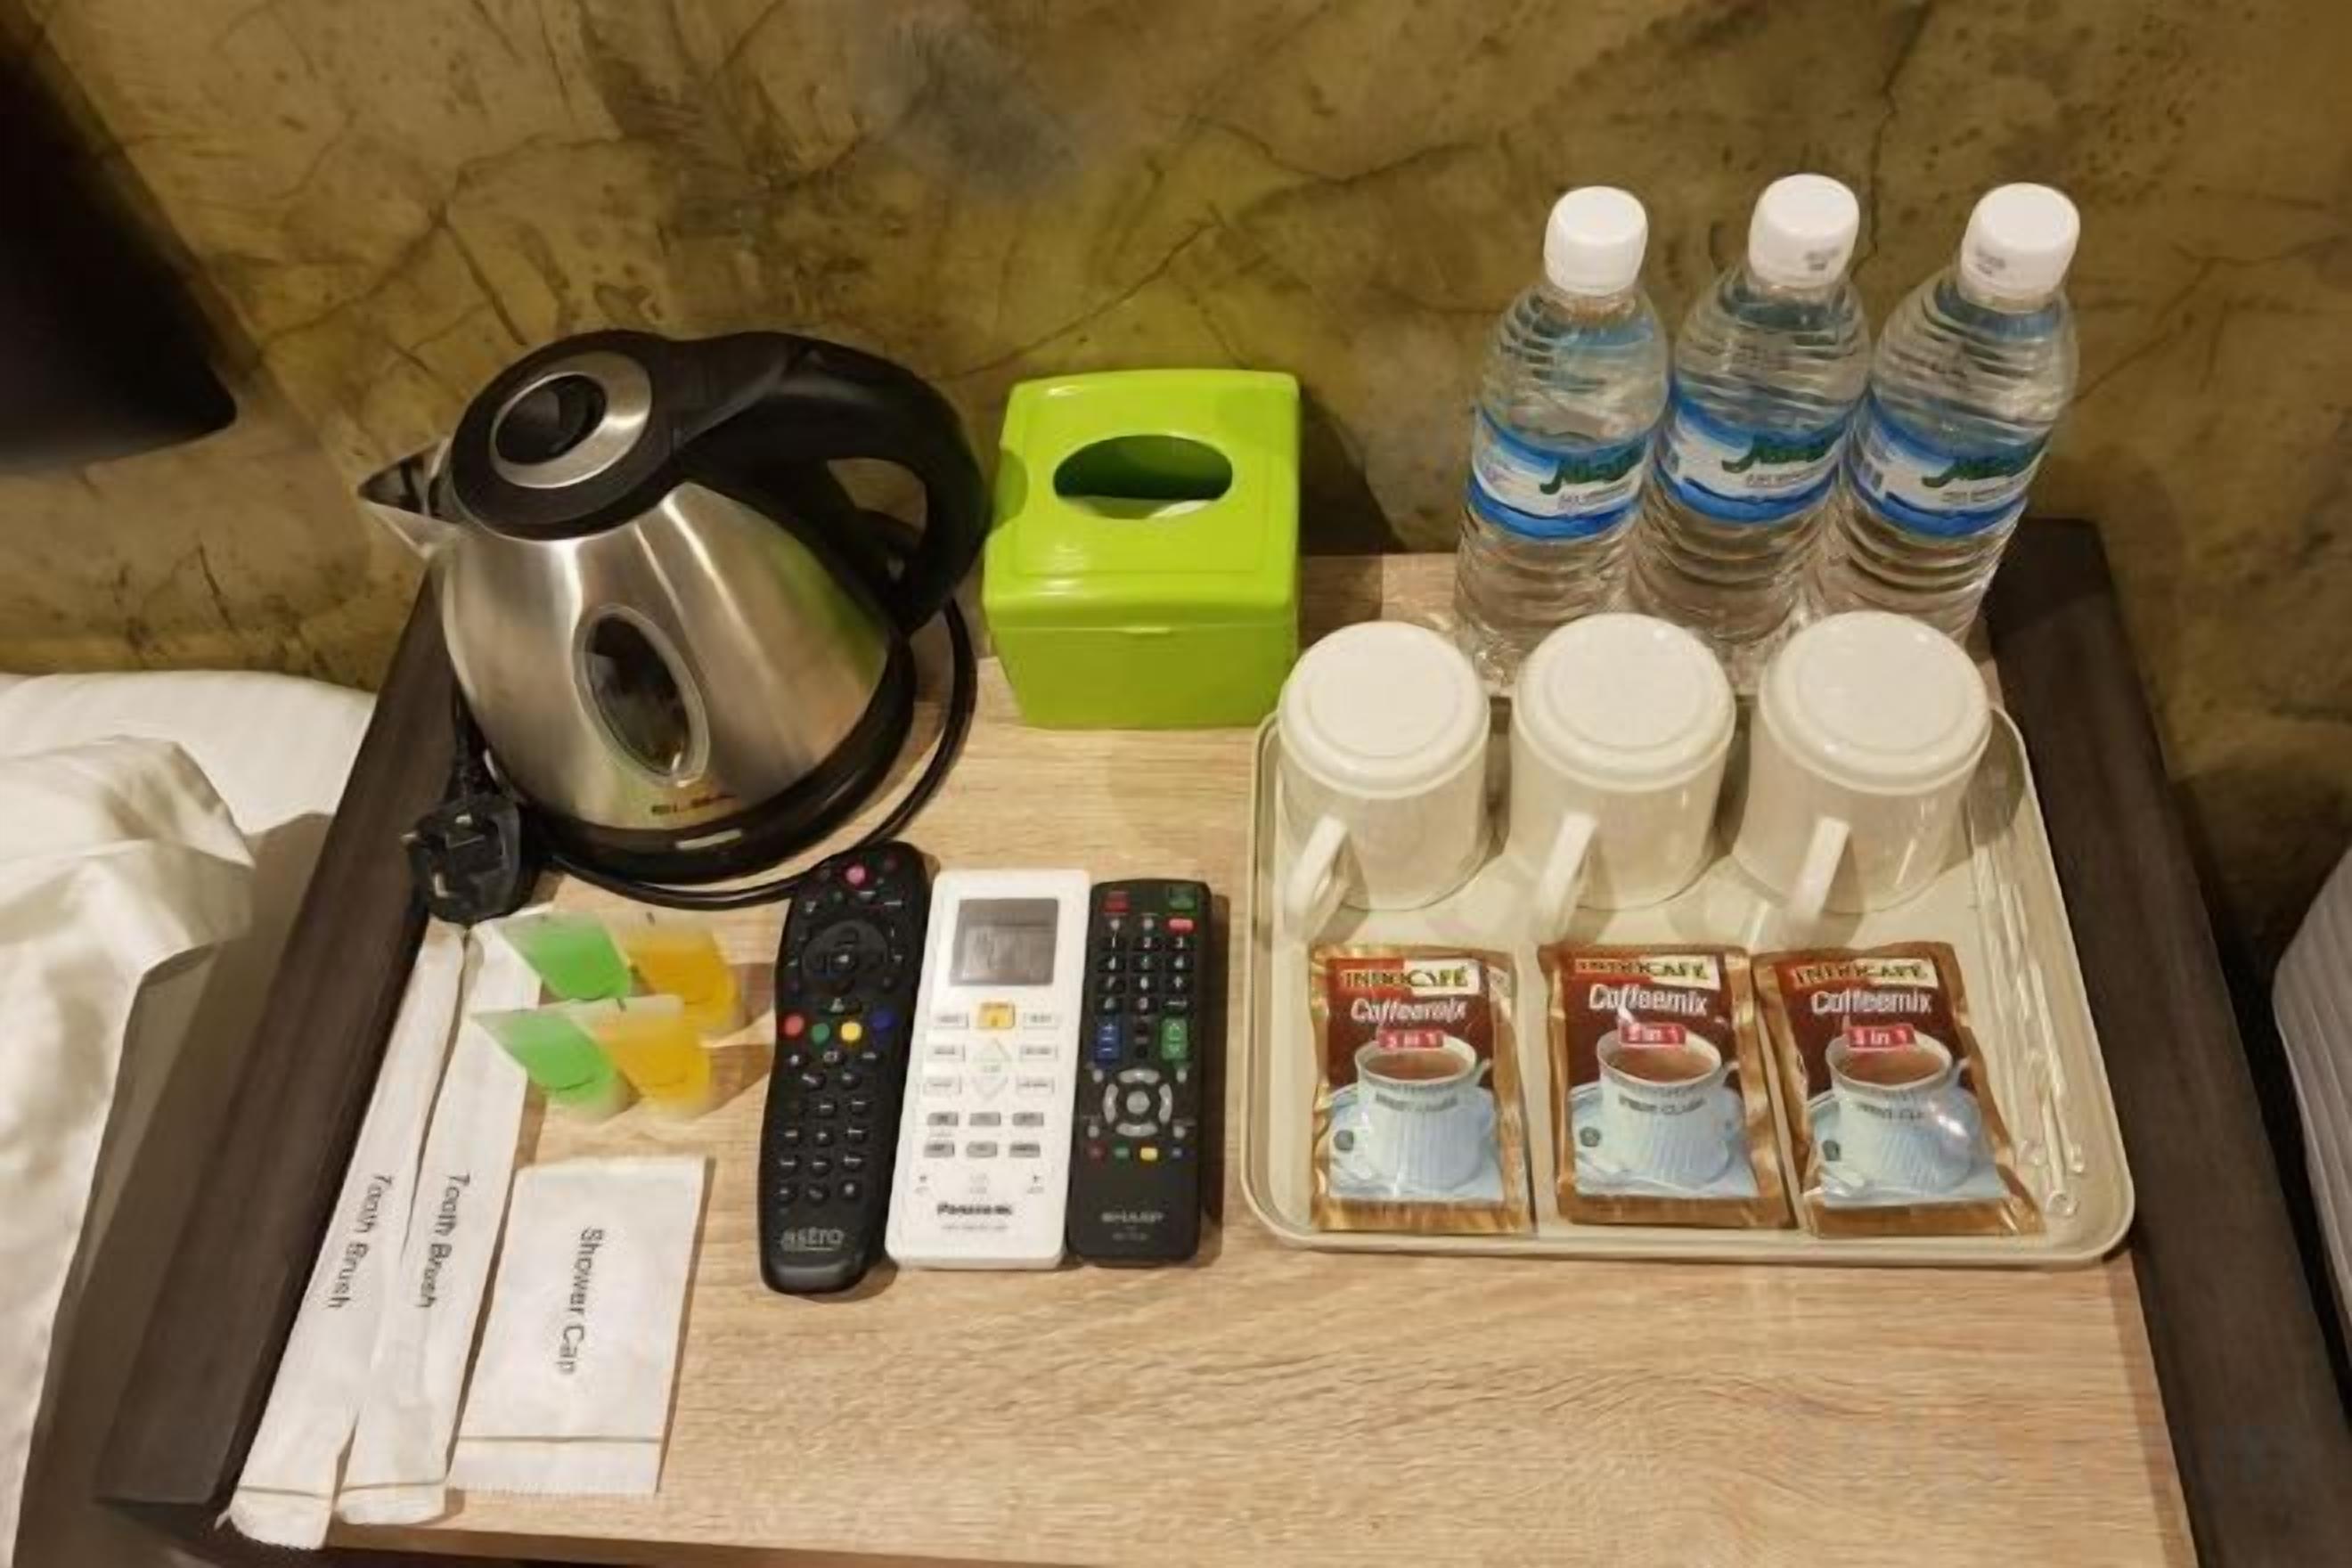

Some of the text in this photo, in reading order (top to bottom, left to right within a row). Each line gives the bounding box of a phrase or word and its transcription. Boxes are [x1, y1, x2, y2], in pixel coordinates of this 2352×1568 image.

[1589, 983, 1708, 1017] Coffeemix
[1811, 988, 1932, 1015] Coffeemix
[324, 1173, 393, 1309] Tooth Brush
[416, 1172, 470, 1309] Tooth Brush
[555, 1226, 607, 1375] Shower Cap
